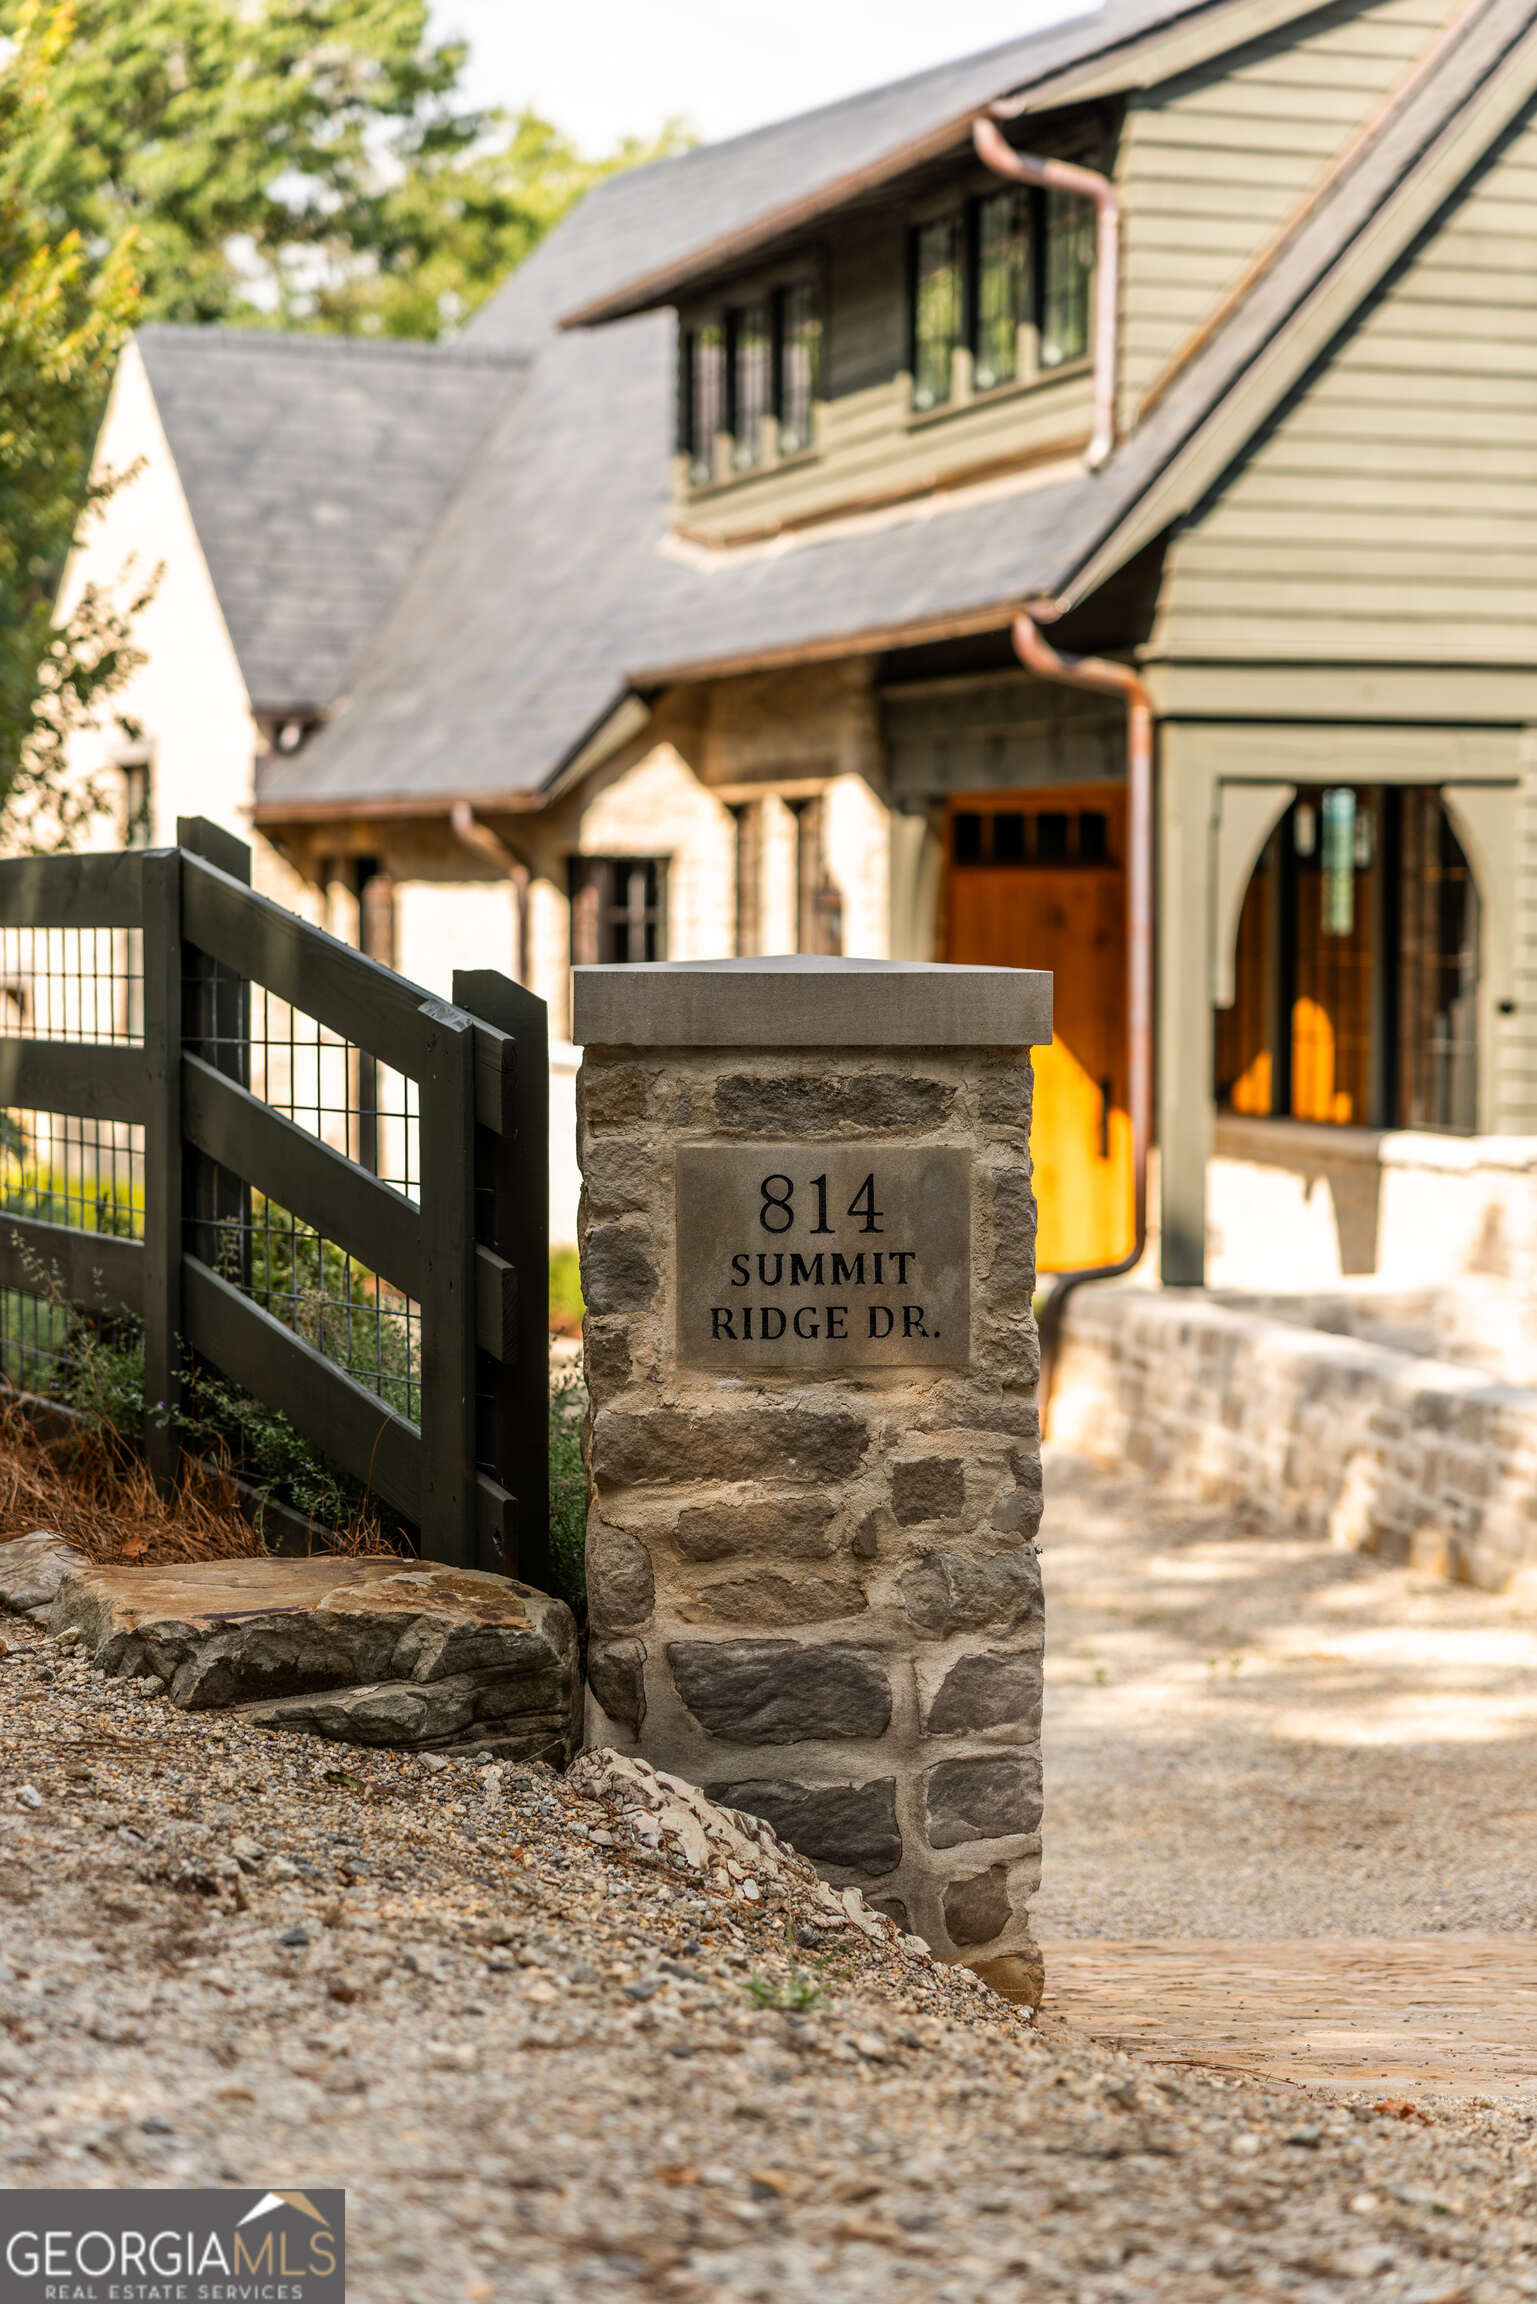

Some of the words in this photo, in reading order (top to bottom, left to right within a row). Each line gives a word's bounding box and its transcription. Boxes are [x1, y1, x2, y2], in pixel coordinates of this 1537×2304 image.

[759, 1173, 884, 1234] 814
[730, 1252, 916, 1287] SUMMIT
[710, 1306, 848, 1340] RIDGE
[867, 1305, 941, 1339] DR.
